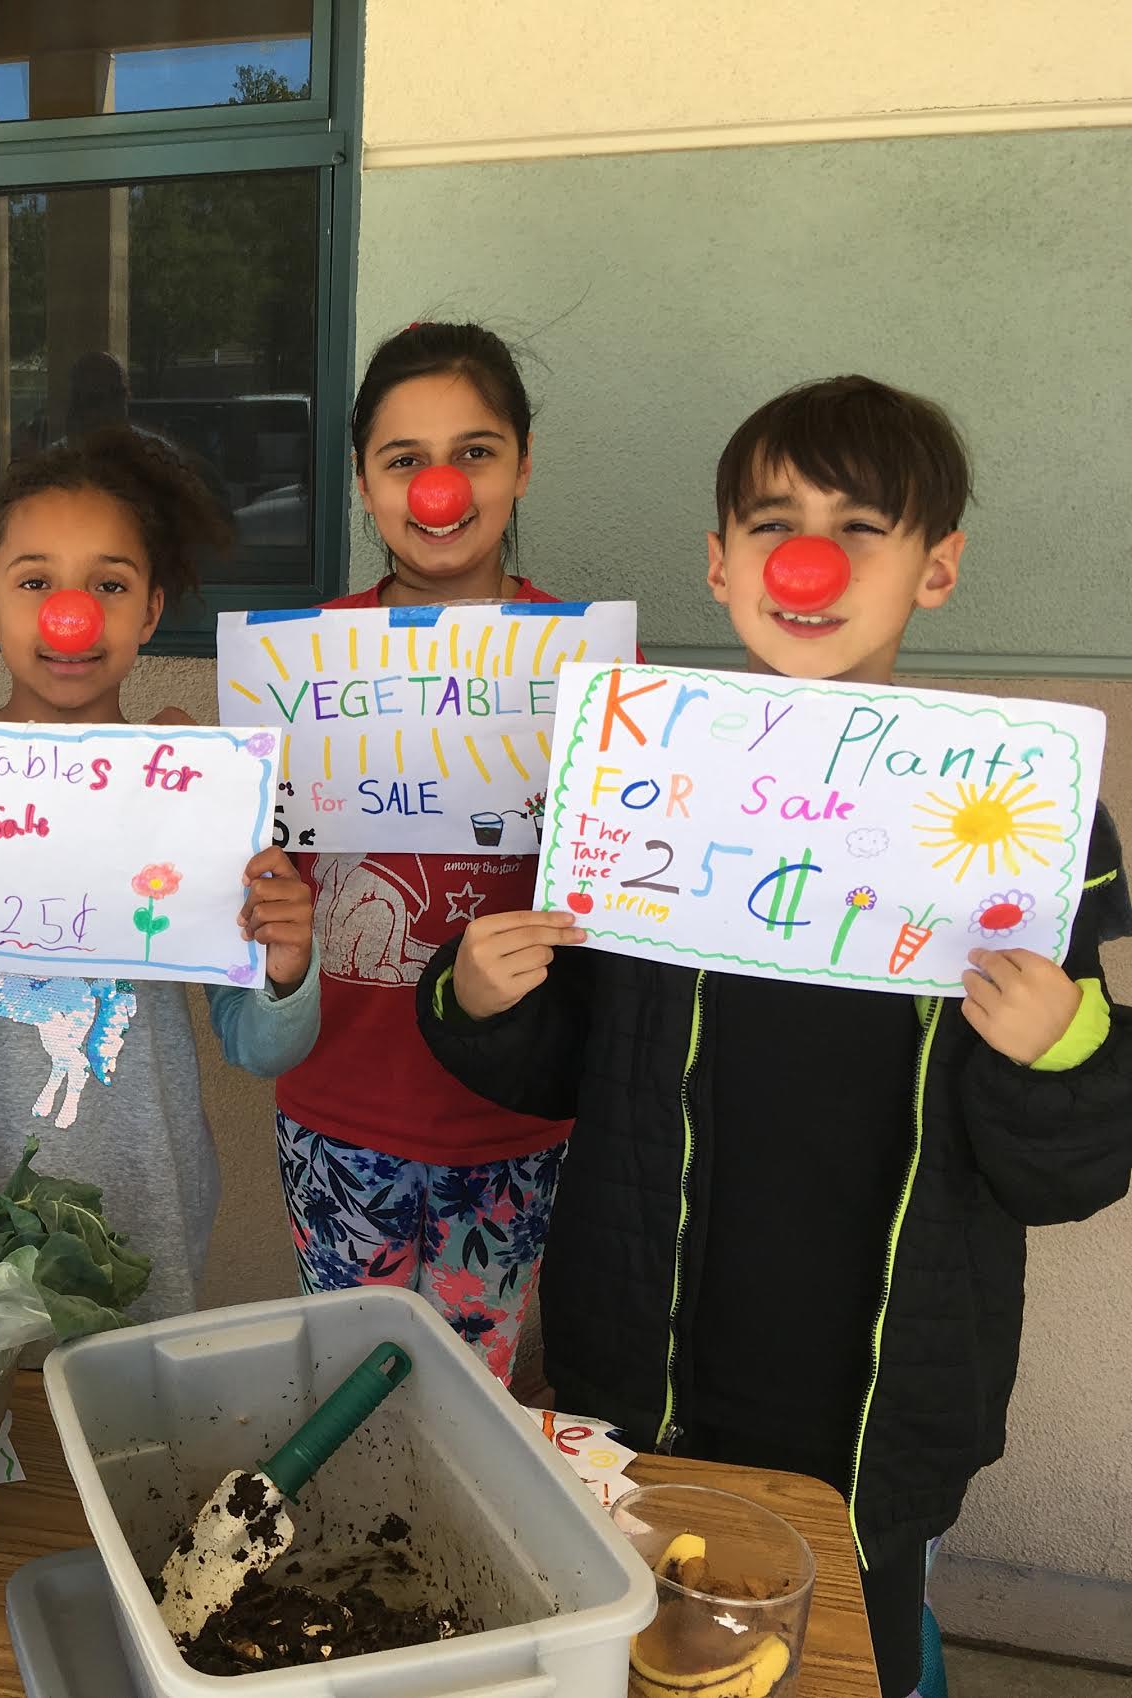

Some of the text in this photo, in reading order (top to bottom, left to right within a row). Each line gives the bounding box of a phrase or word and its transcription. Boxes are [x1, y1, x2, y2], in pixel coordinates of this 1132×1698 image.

[268, 675, 556, 723] VEGETABLE
[824, 706, 1044, 787] Plants
[143, 744, 202, 792] for
[311, 779, 443, 815] for SALE
[591, 765, 855, 822] FOR Sale
[576, 812, 631, 845] They
[443, 861, 481, 875] among
[482, 861, 499, 874] the
[570, 841, 621, 864] Taste
[572, 864, 612, 878] like
